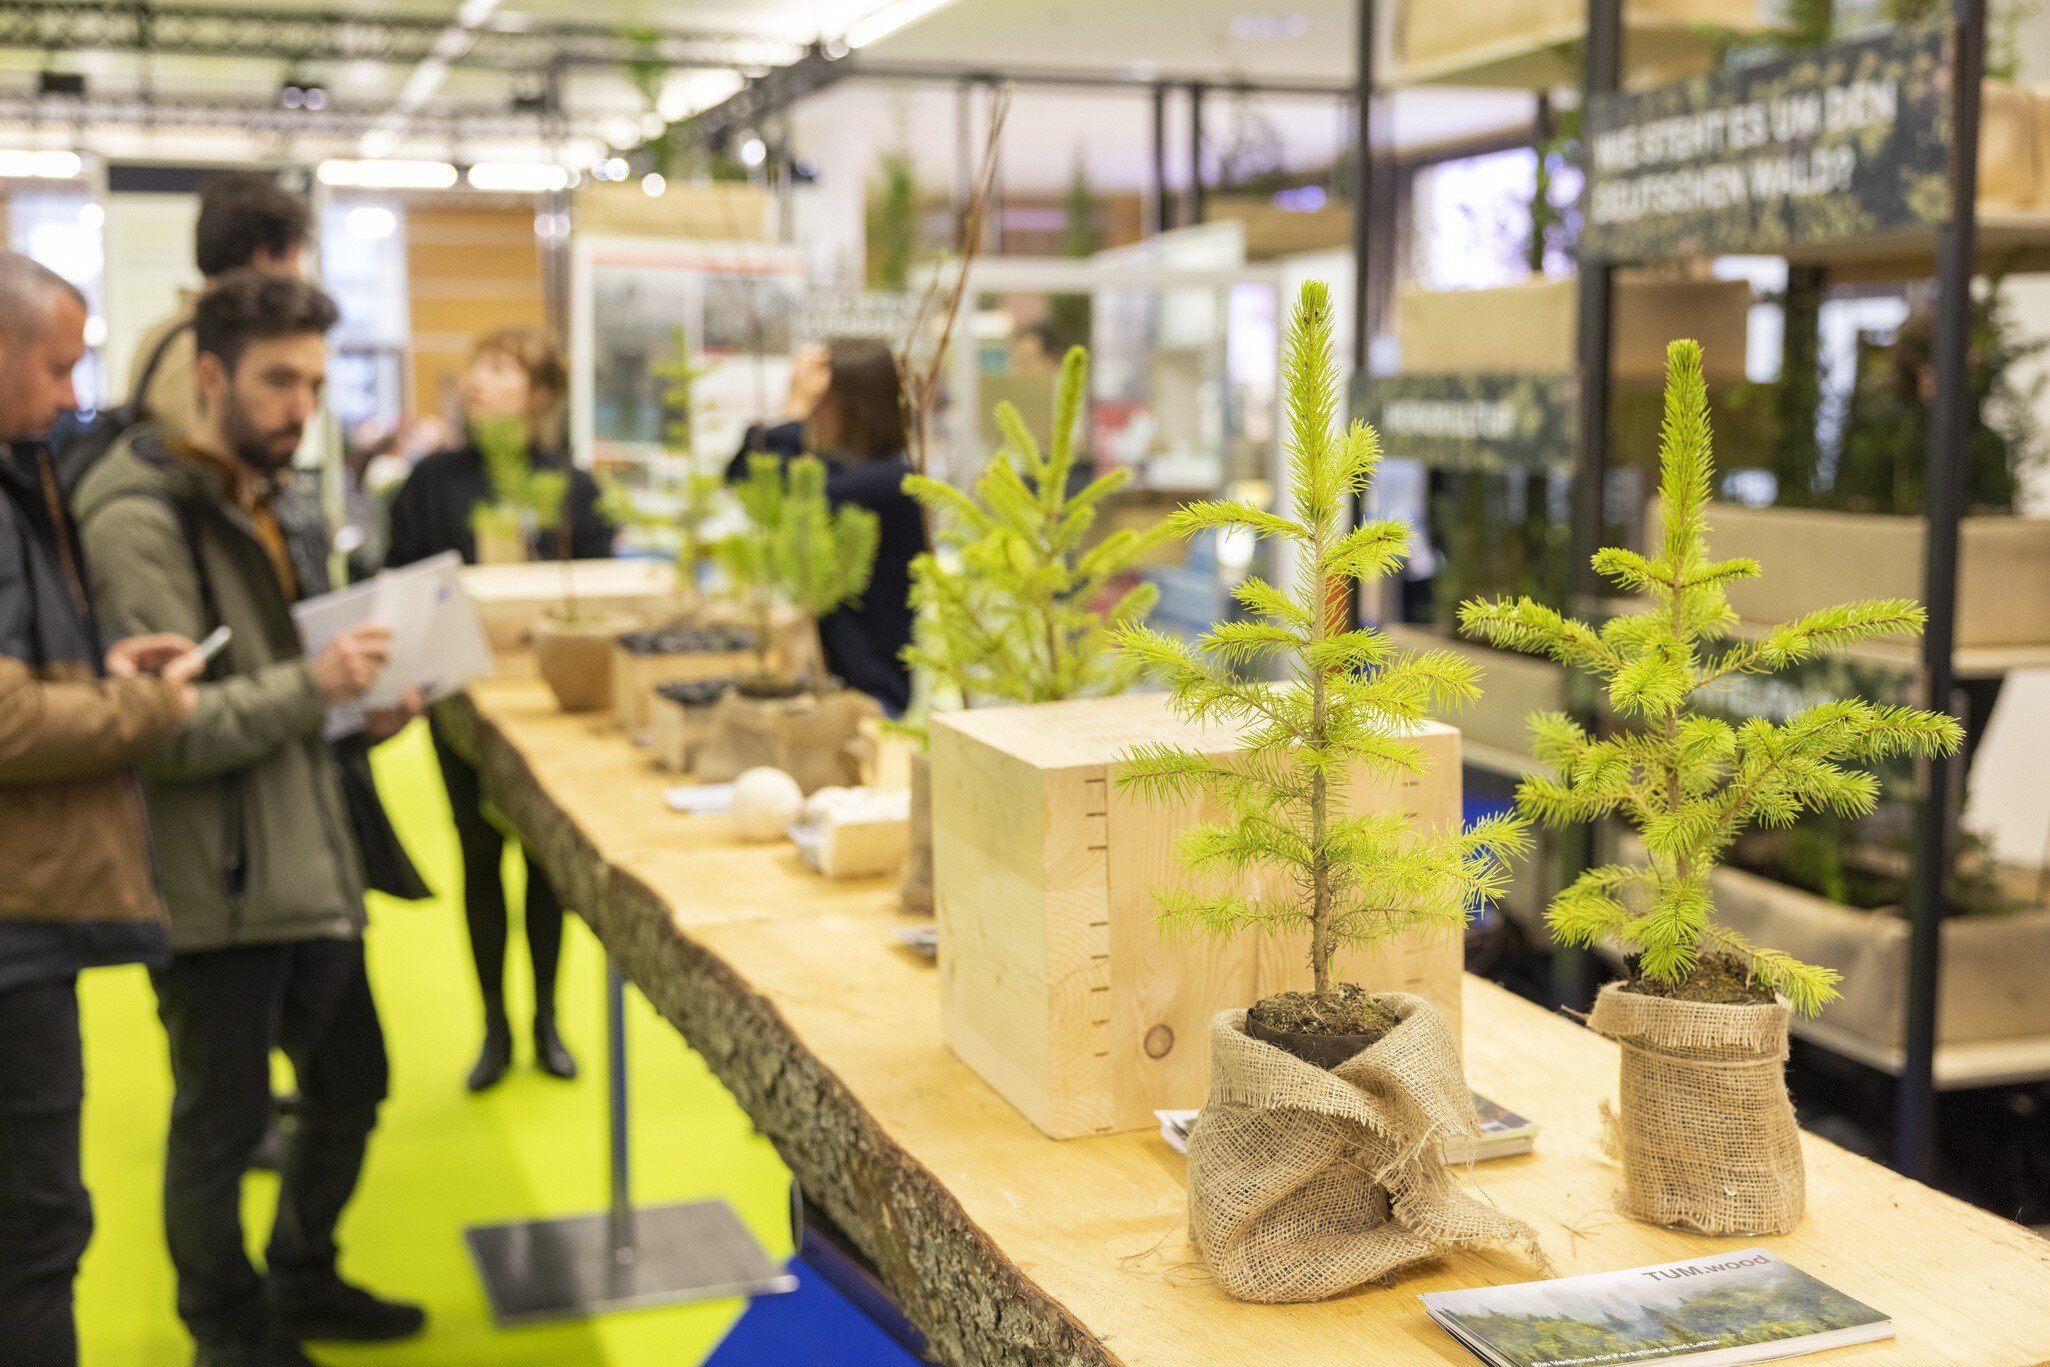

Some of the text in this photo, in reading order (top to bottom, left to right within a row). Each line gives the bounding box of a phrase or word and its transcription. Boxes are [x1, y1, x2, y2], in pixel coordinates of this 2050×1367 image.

[1638, 112, 1725, 164] STEHT
[1727, 102, 1768, 149] ES
[1769, 92, 1822, 142] UM
[1824, 79, 1897, 131] DEN
[1642, 1254, 1771, 1281] TUM.wood
[1550, 1356, 1596, 1366] Verbund
[1611, 1347, 1669, 1359] Forschung
[1668, 1343, 1690, 1351] und
